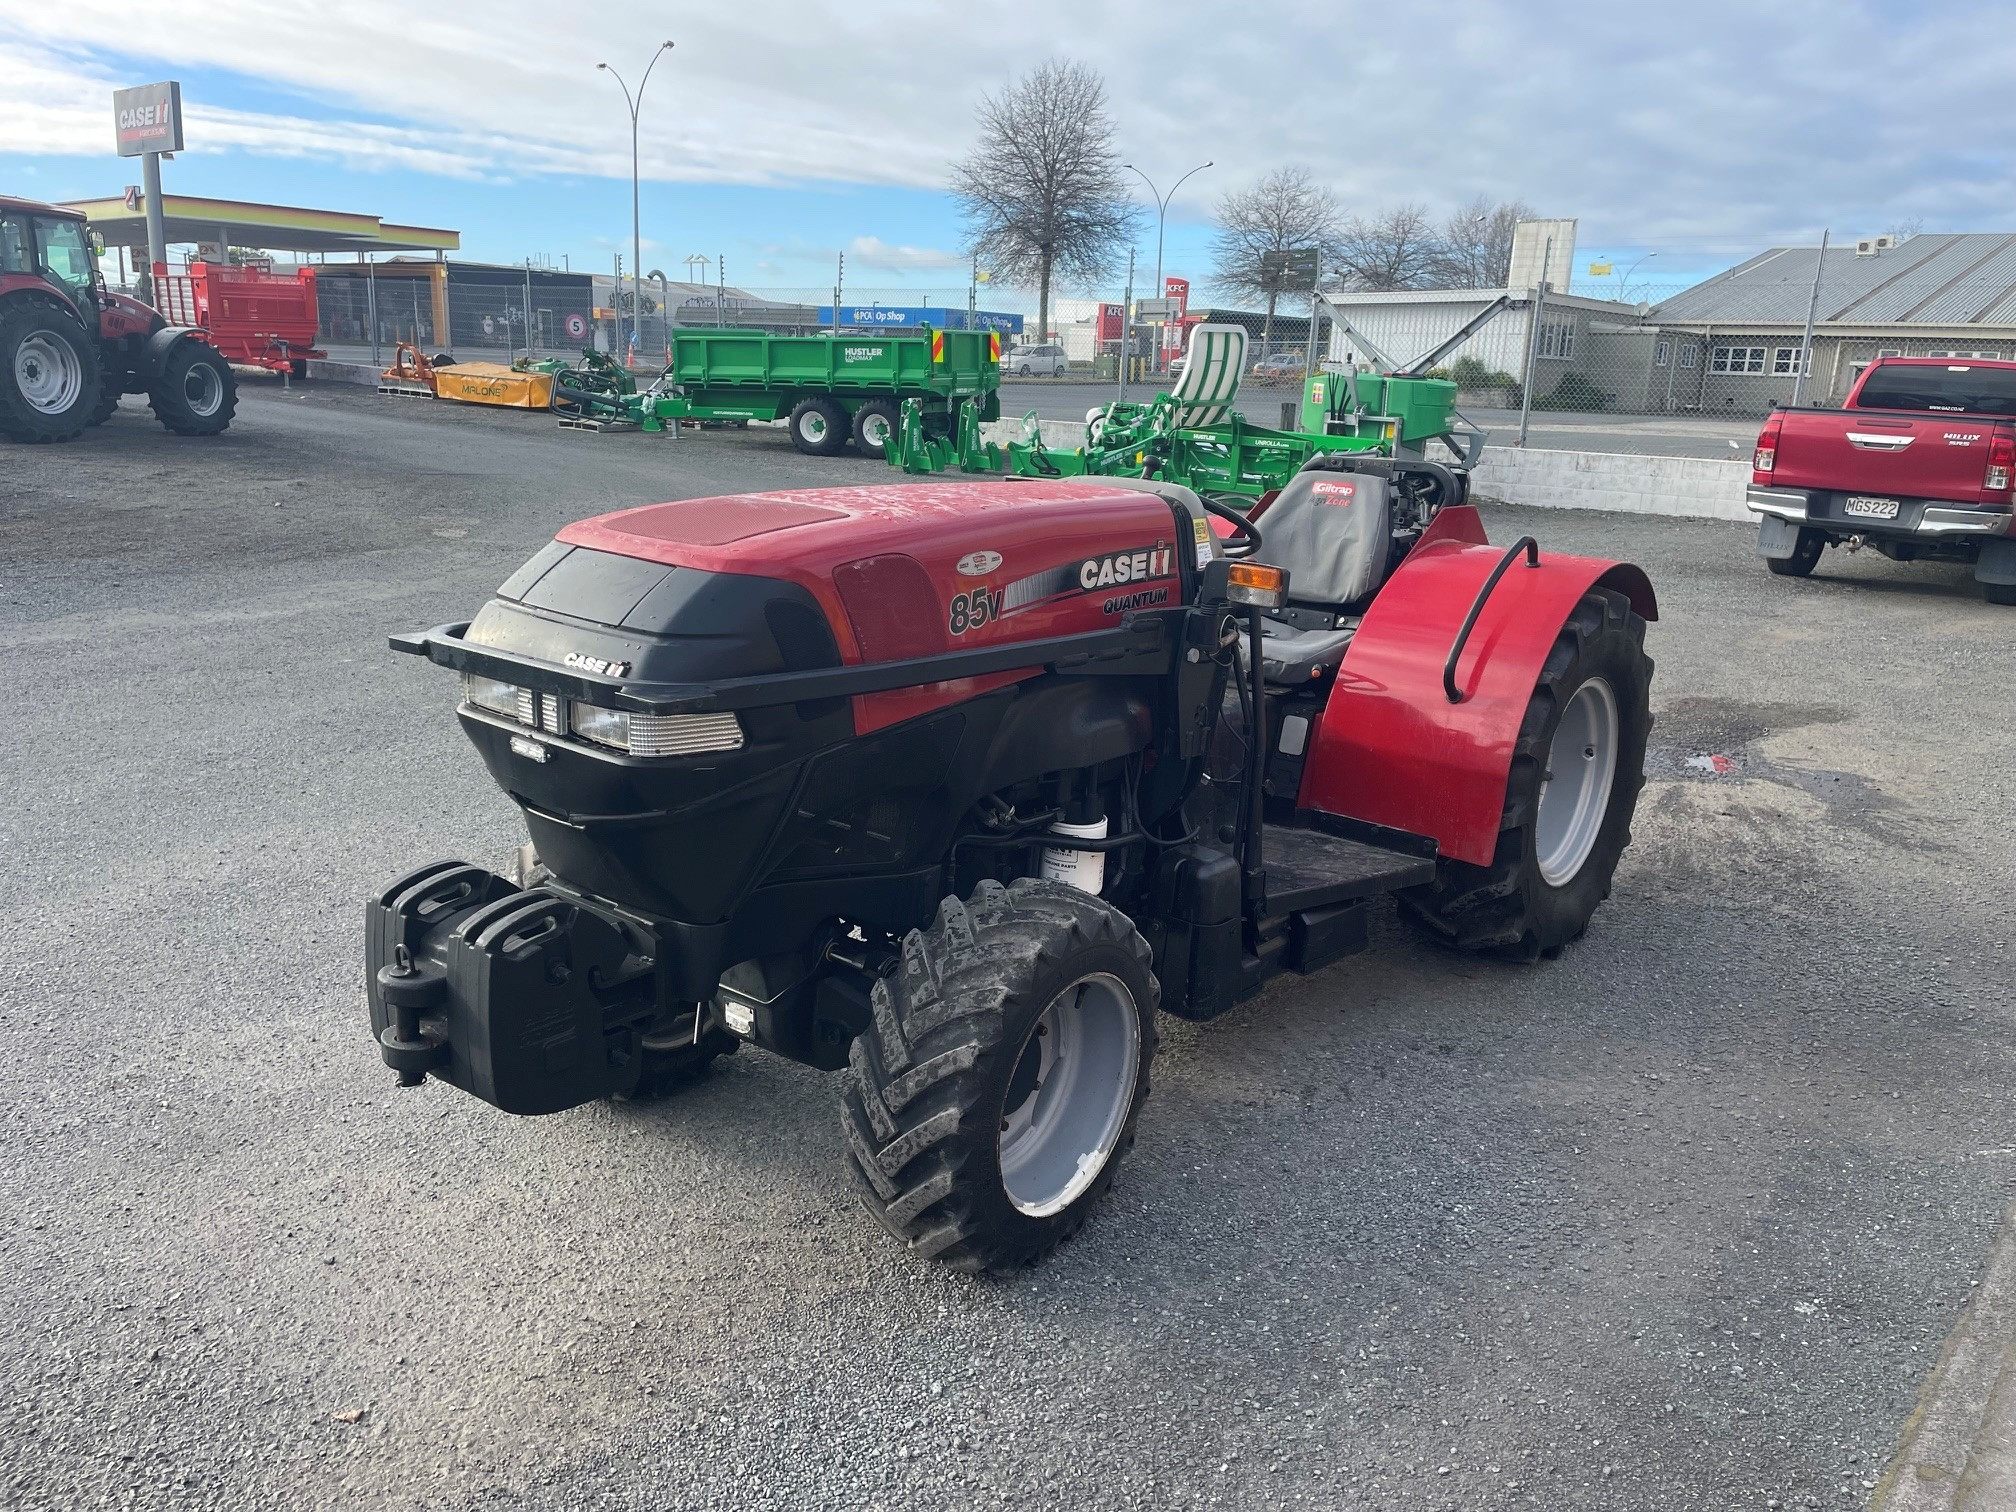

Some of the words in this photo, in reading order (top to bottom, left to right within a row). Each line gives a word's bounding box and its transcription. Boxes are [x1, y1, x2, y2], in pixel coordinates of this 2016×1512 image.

[120, 106, 155, 129] CASE
[1166, 284, 1185, 292] KFC
[876, 311, 886, 323] Op
[887, 311, 905, 323] Shop
[1107, 306, 1124, 317] KFC
[572, 321, 580, 332] 5
[844, 347, 883, 356] HUSTLER
[462, 384, 501, 397] MALONE
[1193, 433, 1216, 441] HUSTLER
[1943, 432, 1981, 441] HILUX
[1255, 439, 1281, 447] UNROLLA
[1100, 452, 1123, 465] HUSTLER
[1316, 483, 1353, 496] Giltrap
[1847, 500, 1897, 515] MGS222
[1759, 541, 1791, 551] HILUX
[1080, 553, 1148, 590] CASE
[1103, 587, 1169, 615] QUANTUM
[949, 586, 1003, 636] 85V
[564, 653, 608, 673] CASE
